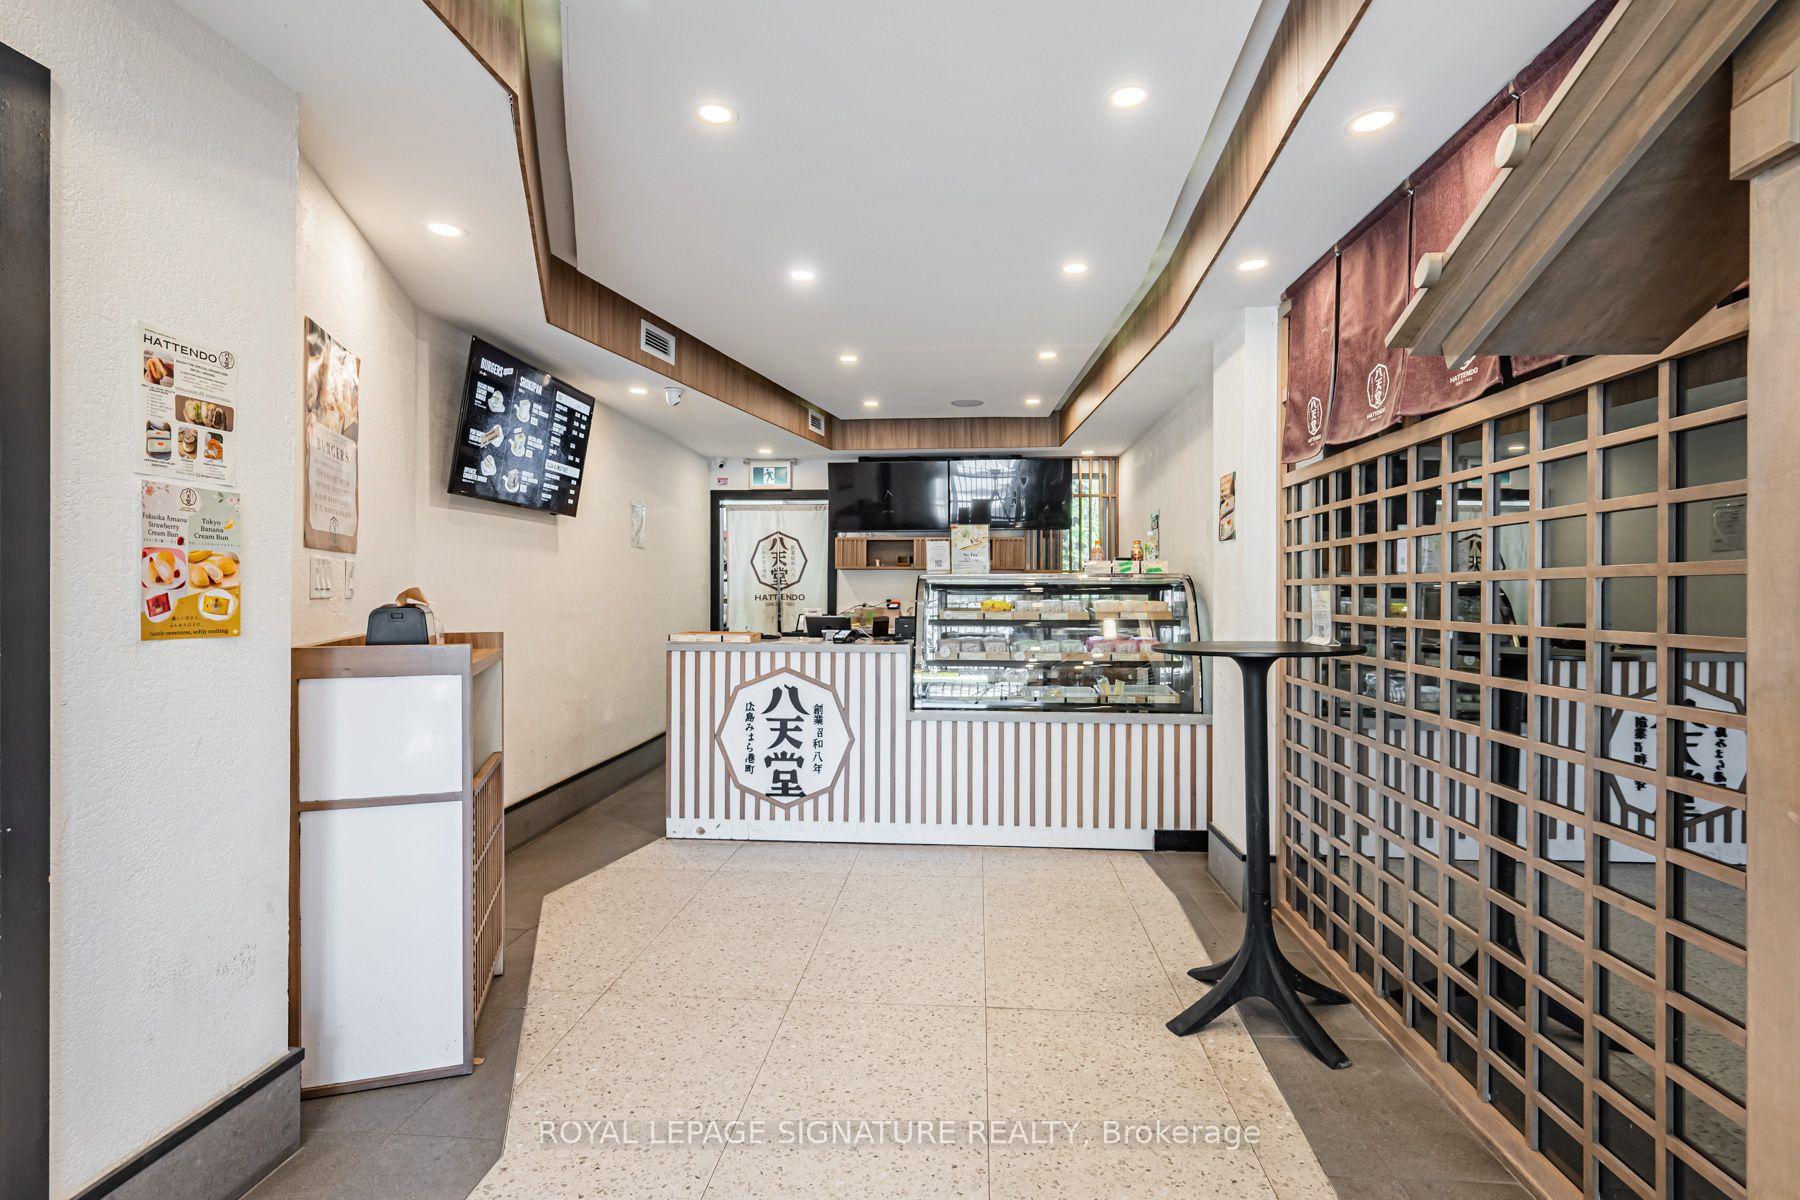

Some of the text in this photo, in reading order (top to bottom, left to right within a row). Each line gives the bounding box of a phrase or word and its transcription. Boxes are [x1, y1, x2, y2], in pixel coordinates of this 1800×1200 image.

[143, 333, 217, 363] HATTENDO
[481, 357, 503, 377] BURGERS
[1450, 366, 1478, 383] HATTENDO
[317, 438, 350, 463] BURGERS
[148, 521, 179, 531] Strawberry
[202, 518, 221, 526] Tokyo
[761, 684, 810, 797] 八天堂
